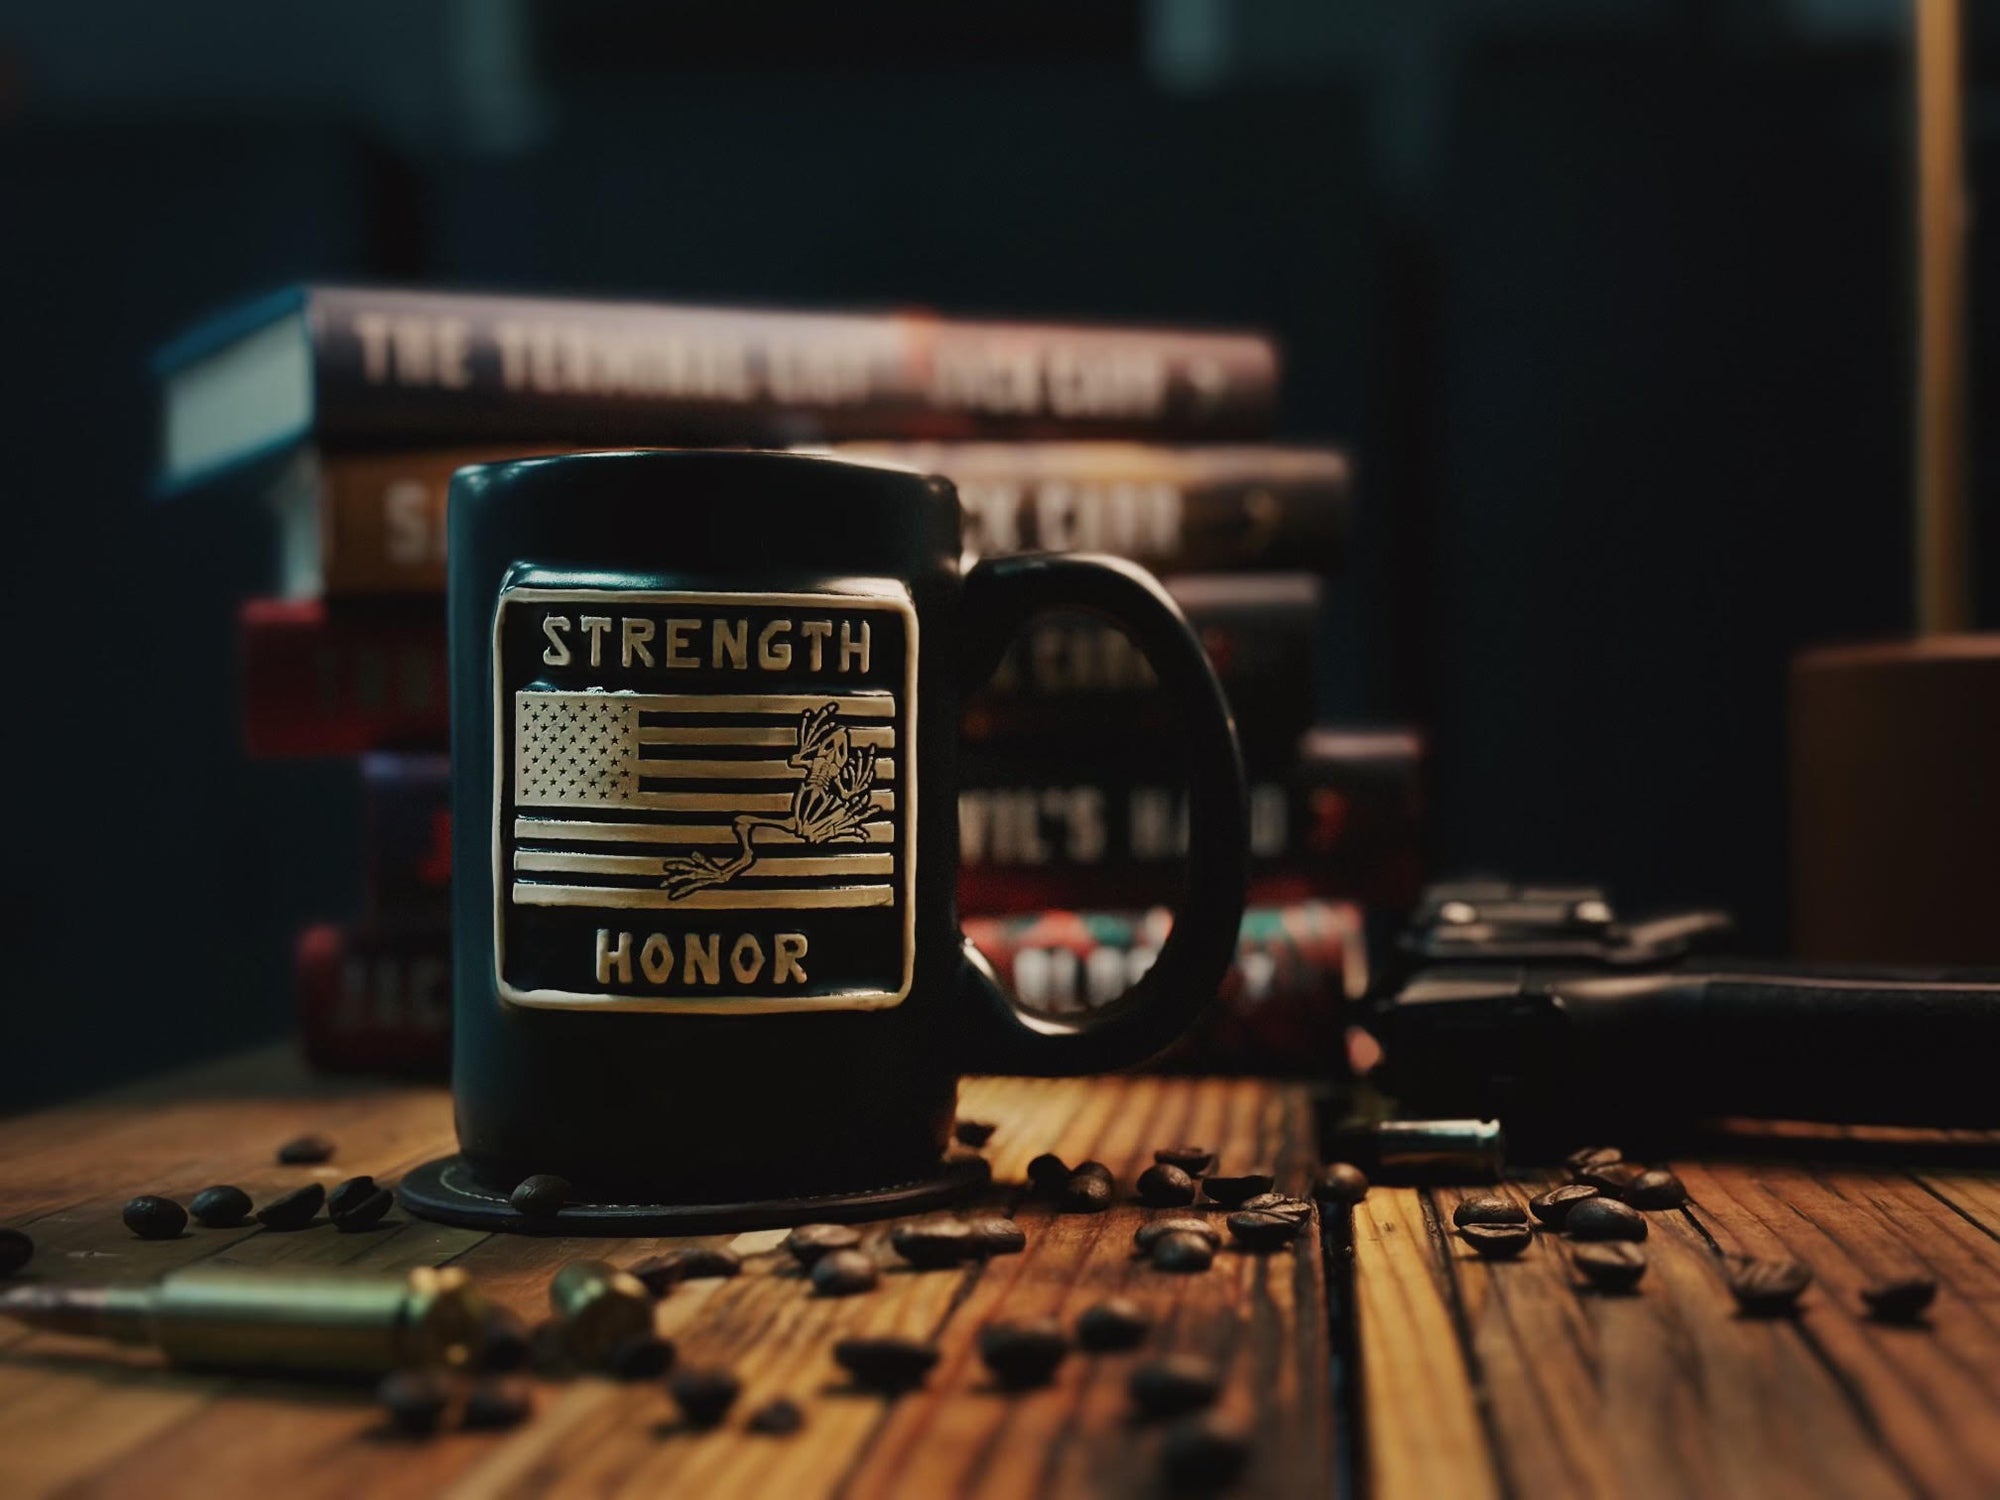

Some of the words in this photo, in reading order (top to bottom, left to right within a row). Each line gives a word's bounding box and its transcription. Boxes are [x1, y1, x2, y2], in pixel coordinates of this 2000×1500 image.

[354, 313, 474, 391] THE
[542, 615, 872, 674] STRENGTH
[596, 929, 809, 985] HONOR
